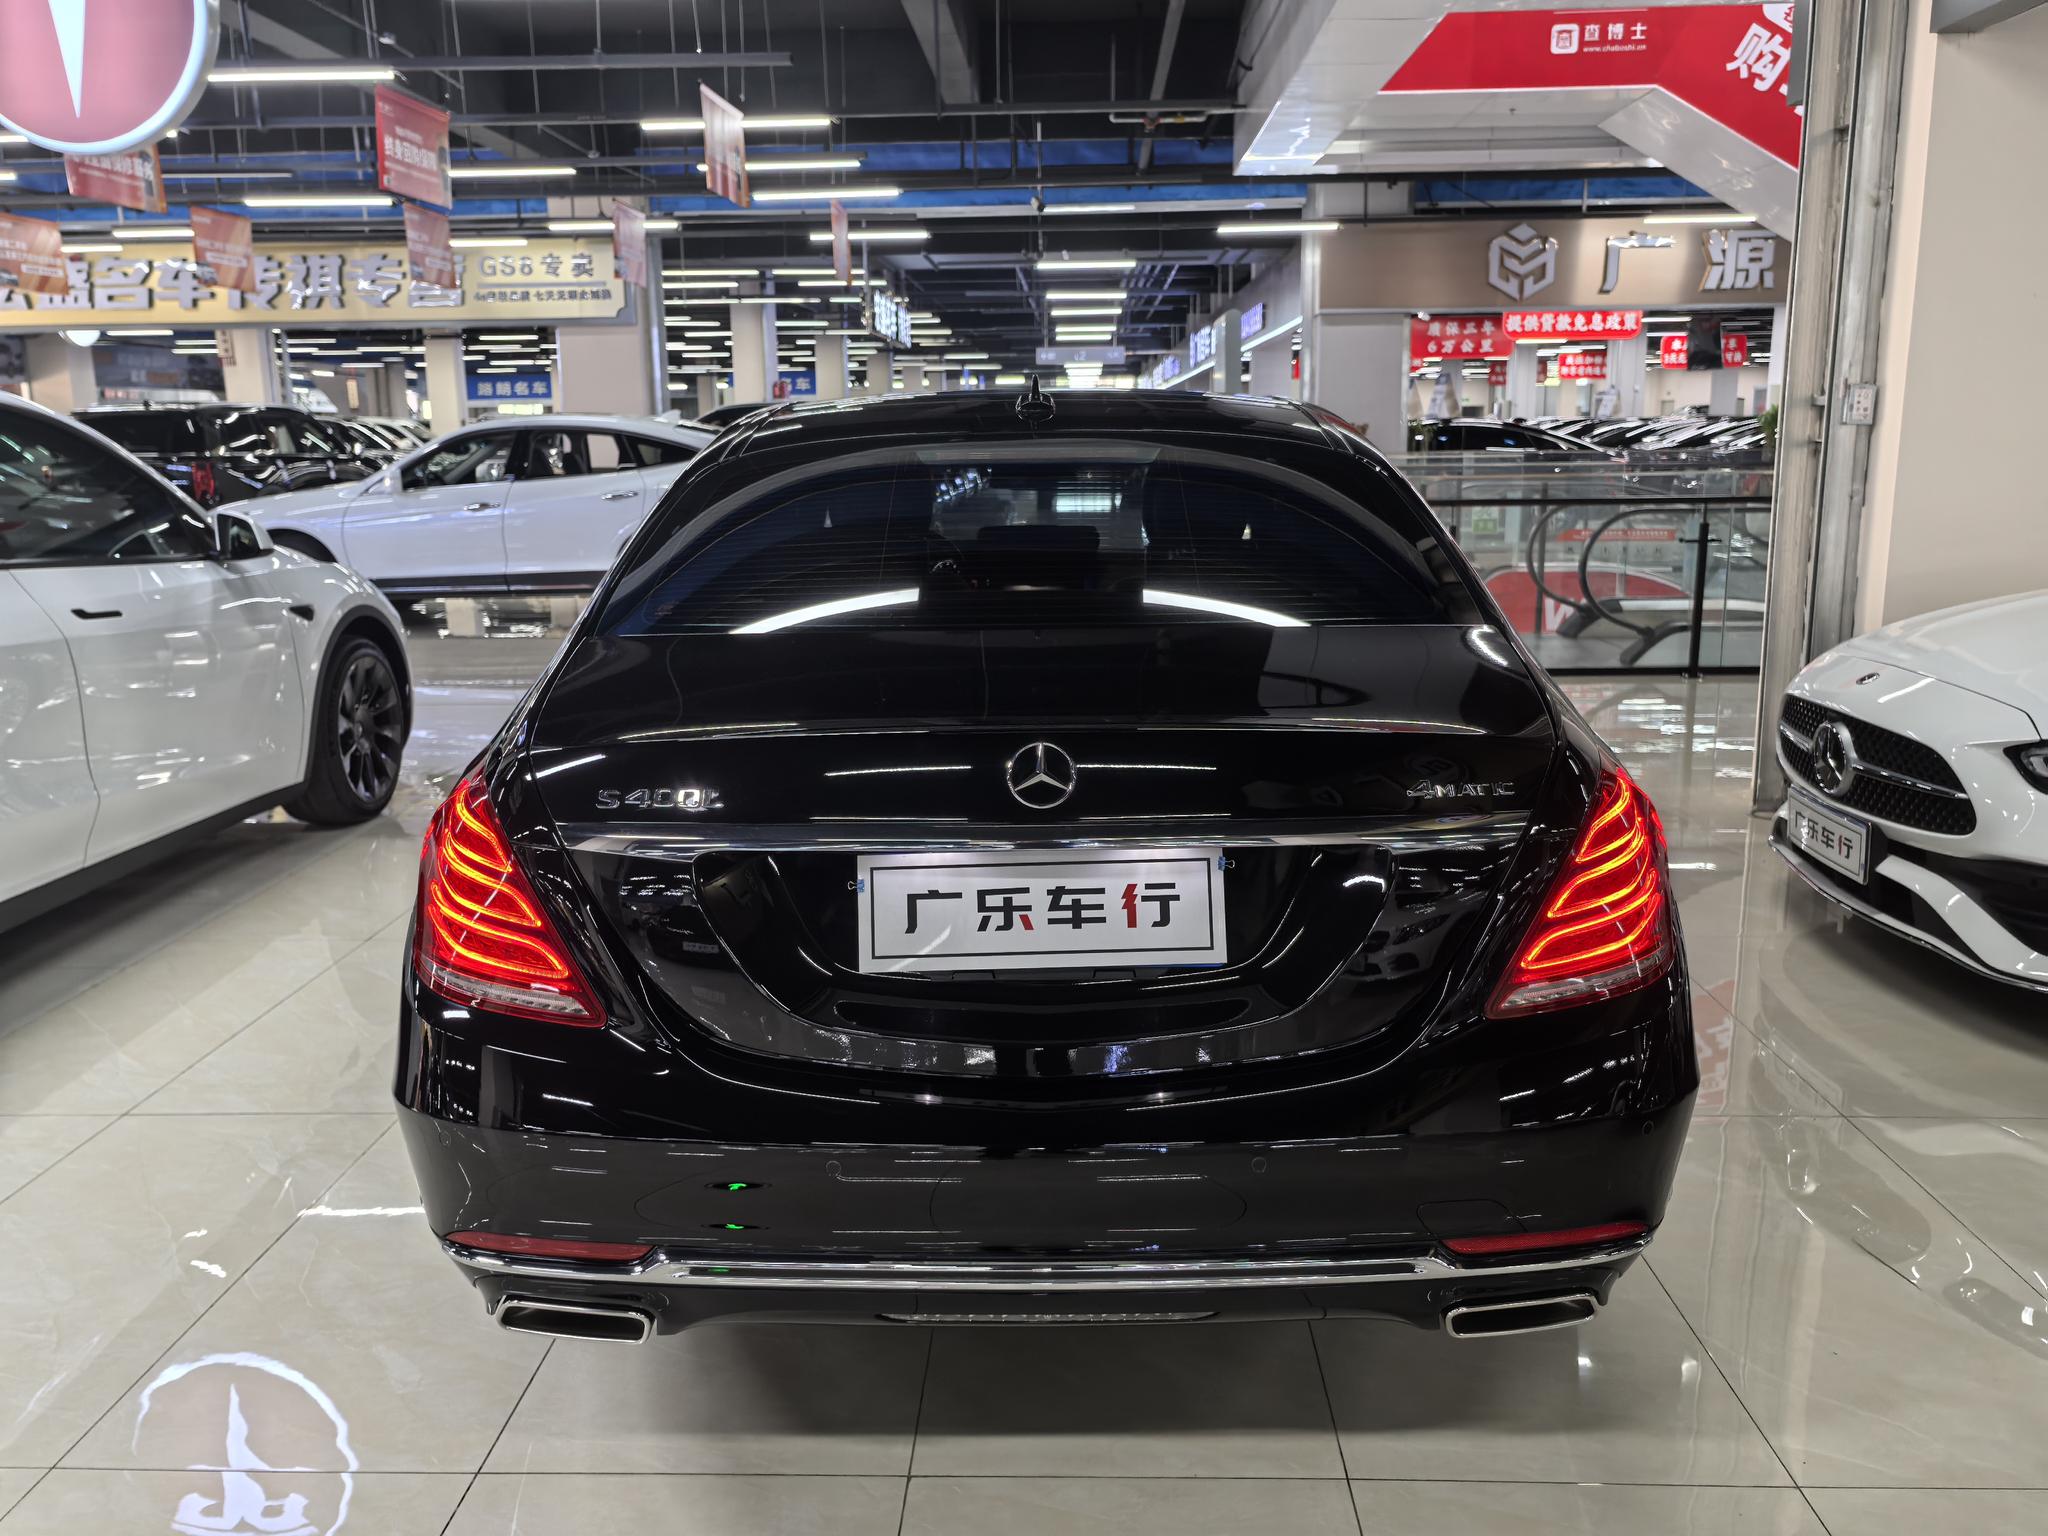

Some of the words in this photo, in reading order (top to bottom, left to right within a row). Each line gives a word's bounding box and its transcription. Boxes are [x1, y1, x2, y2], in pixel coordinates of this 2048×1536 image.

[1584, 22, 1647, 41] 查博士
[1726, 22, 1795, 98] 购
[1598, 229, 1777, 295] 广源
[1506, 313, 1638, 332] 提供贷款免息政策
[1427, 339, 1494, 354] 6万公里
[1406, 779, 1516, 800] 4MATIC
[1794, 810, 1854, 860] 广乐车行
[904, 882, 1181, 935] 广乐车行
